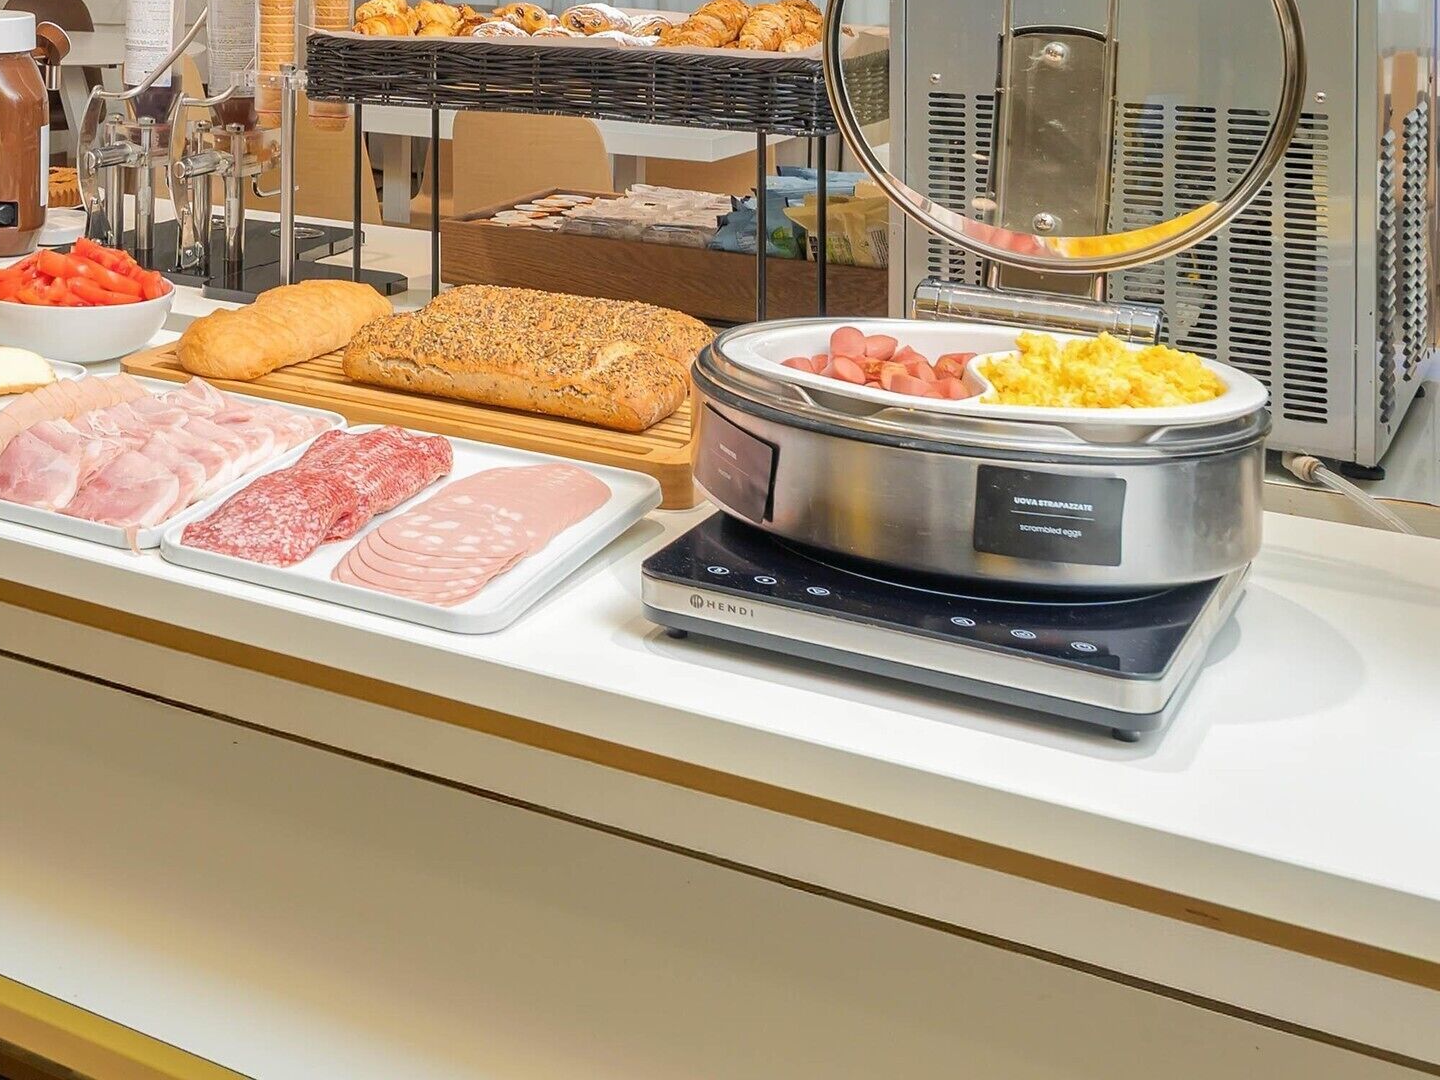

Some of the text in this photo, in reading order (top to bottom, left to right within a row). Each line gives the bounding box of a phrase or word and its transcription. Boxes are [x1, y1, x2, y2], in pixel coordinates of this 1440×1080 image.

[1014, 497, 1093, 511] UOVA STRAPAZZATE
[1019, 524, 1082, 538] scrambled eggs
[706, 601, 754, 617] HENDI
